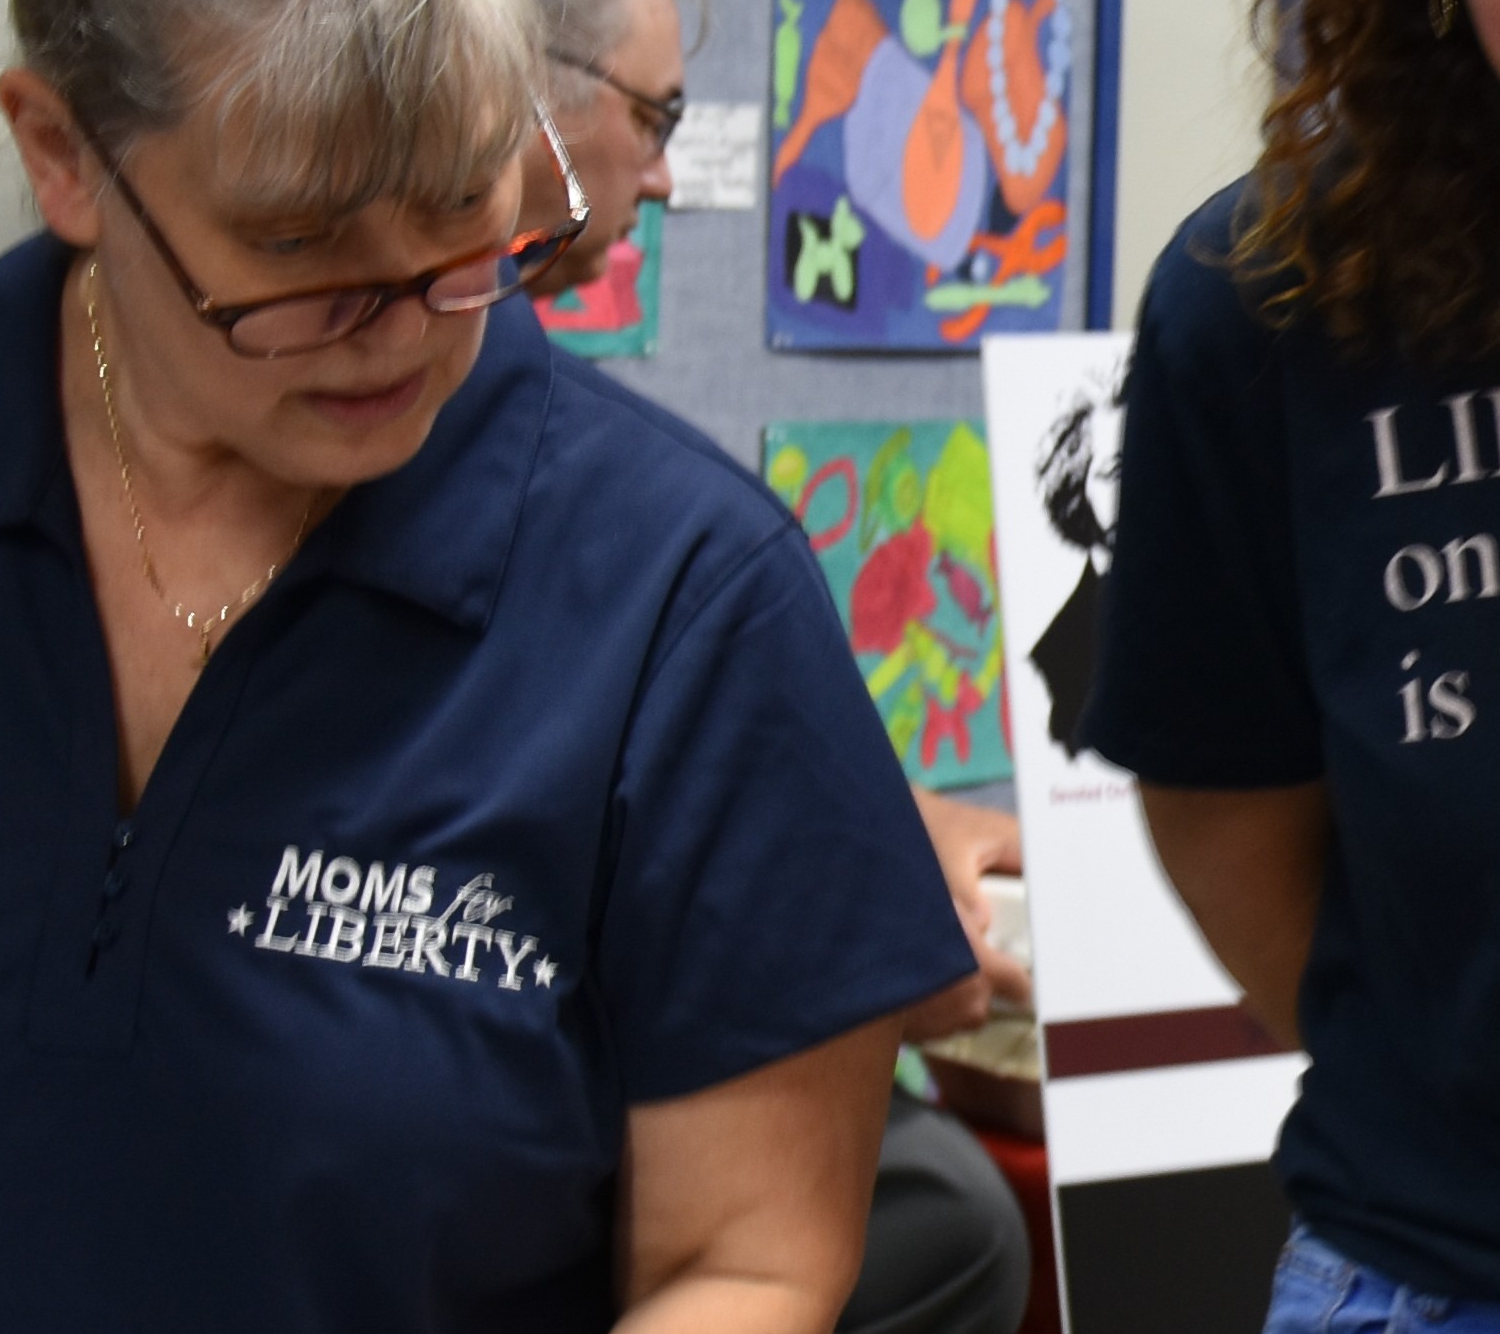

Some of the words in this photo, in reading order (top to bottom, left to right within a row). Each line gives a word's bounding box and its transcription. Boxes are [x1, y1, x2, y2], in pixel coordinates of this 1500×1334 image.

[1397, 650, 1476, 745] is
[271, 844, 438, 915] MOMS
[424, 872, 515, 945] for
[255, 895, 539, 991] LIBERTY
